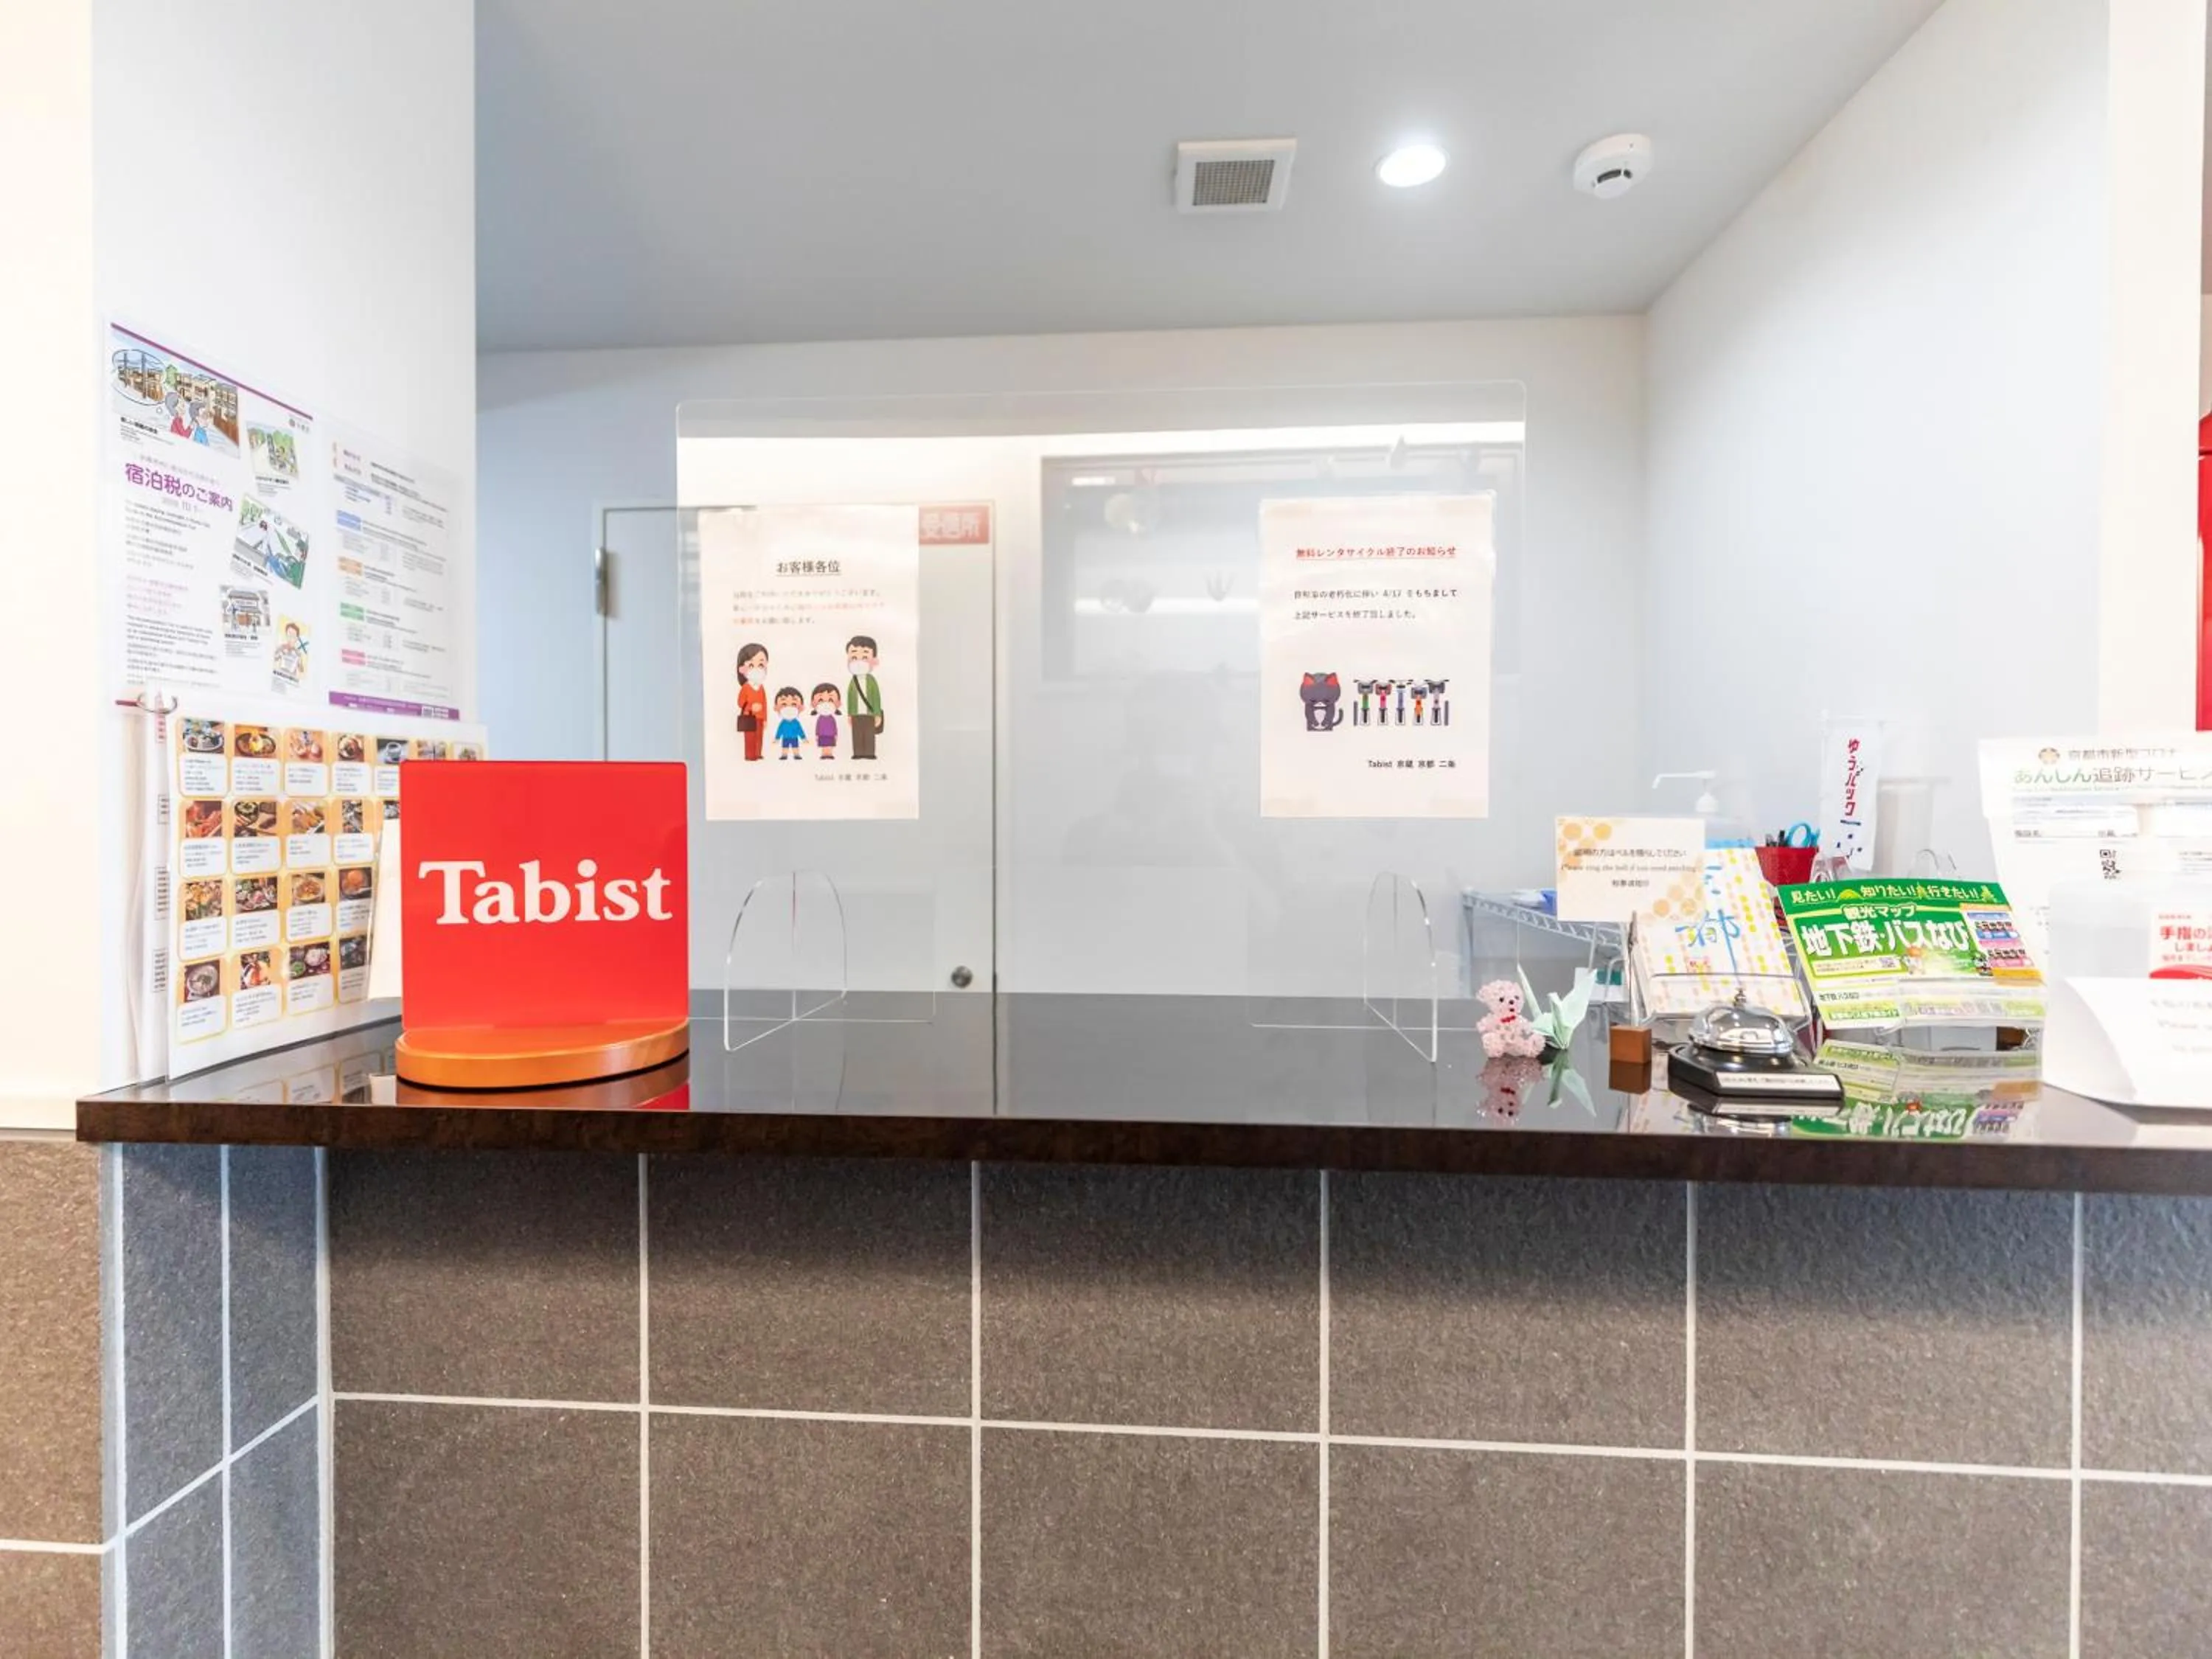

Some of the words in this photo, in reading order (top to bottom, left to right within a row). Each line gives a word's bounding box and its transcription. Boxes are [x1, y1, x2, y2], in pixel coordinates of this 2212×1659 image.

[125, 462, 234, 512] 宿泊税のご案内
[776, 560, 841, 574] お客様各位
[418, 859, 673, 925] Tabist
[1845, 906, 1915, 920] 観光マップ
[1801, 919, 1969, 956] 地下鉄・バスなび
